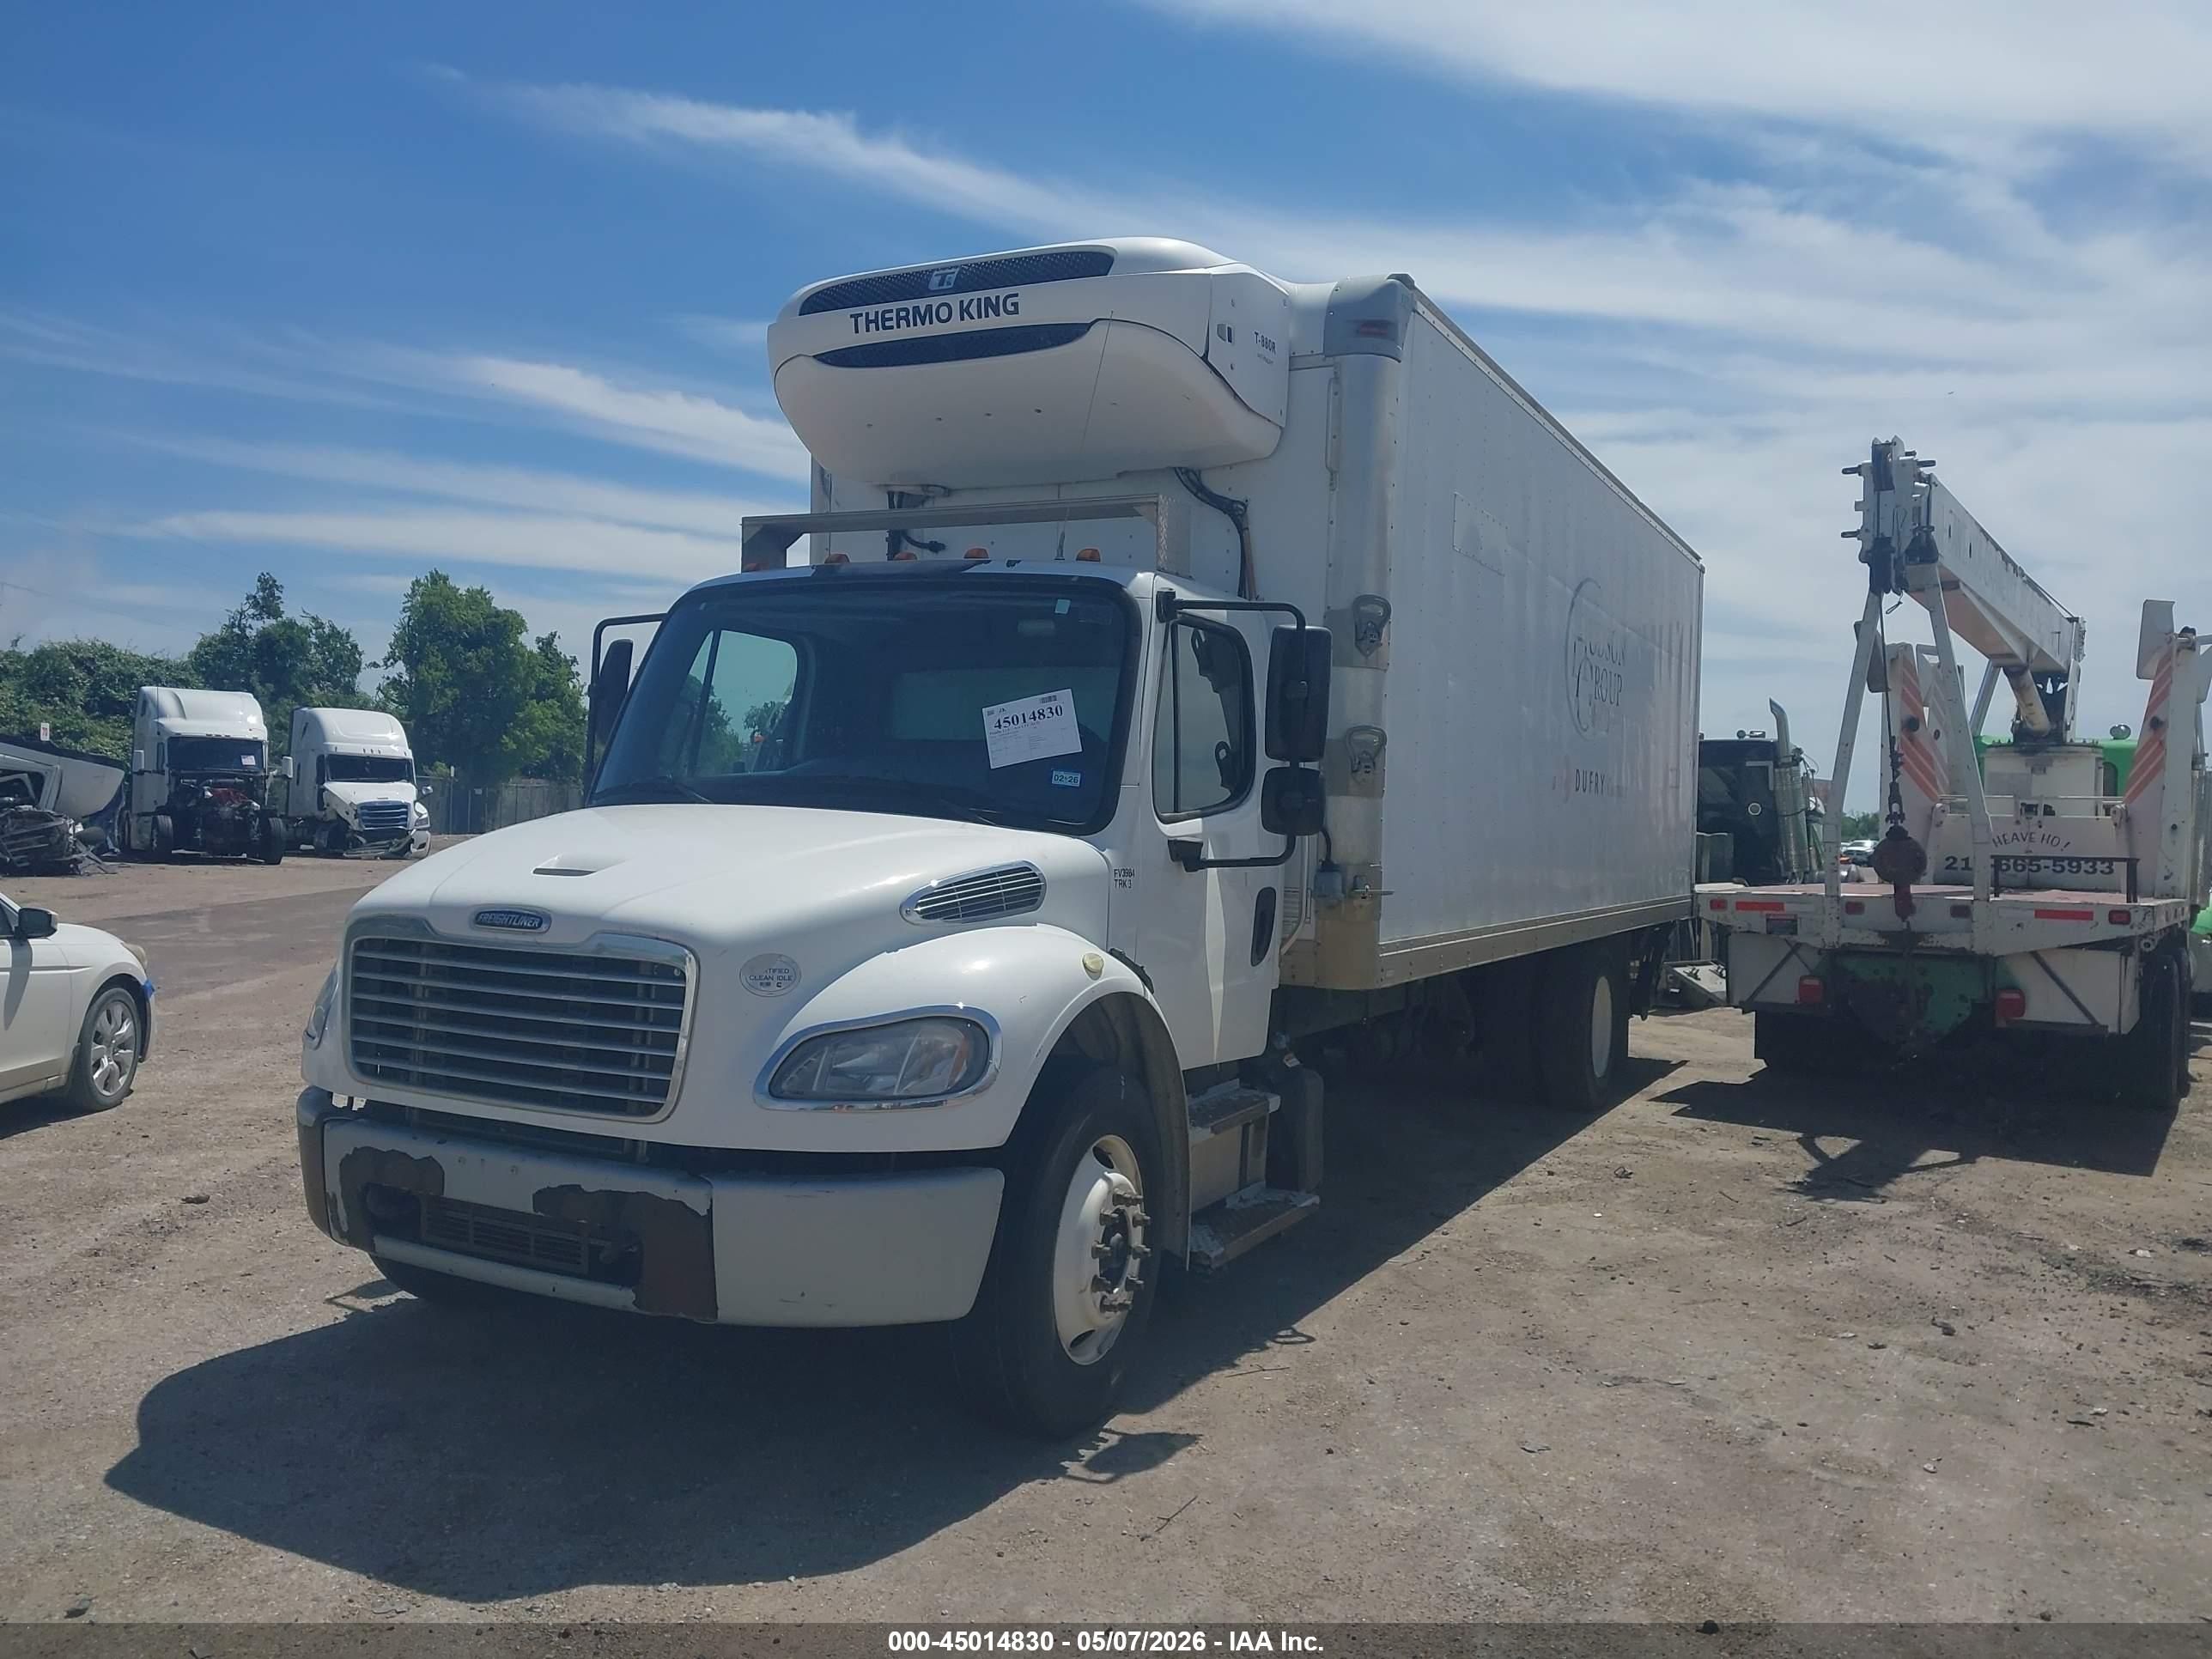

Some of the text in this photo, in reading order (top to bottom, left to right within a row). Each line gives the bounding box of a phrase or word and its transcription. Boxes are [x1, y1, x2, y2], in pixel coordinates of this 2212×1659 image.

[849, 293, 1019, 334] THERMO KING
[994, 704, 1063, 729] 45014830
[1575, 769, 1605, 794] DUFRY
[1992, 831, 2071, 852] HEAVE HO!
[1944, 855, 2115, 875] 21-665-5933
[1114, 878, 1127, 889] TRK
[477, 913, 541, 927] FREIGHTLINER
